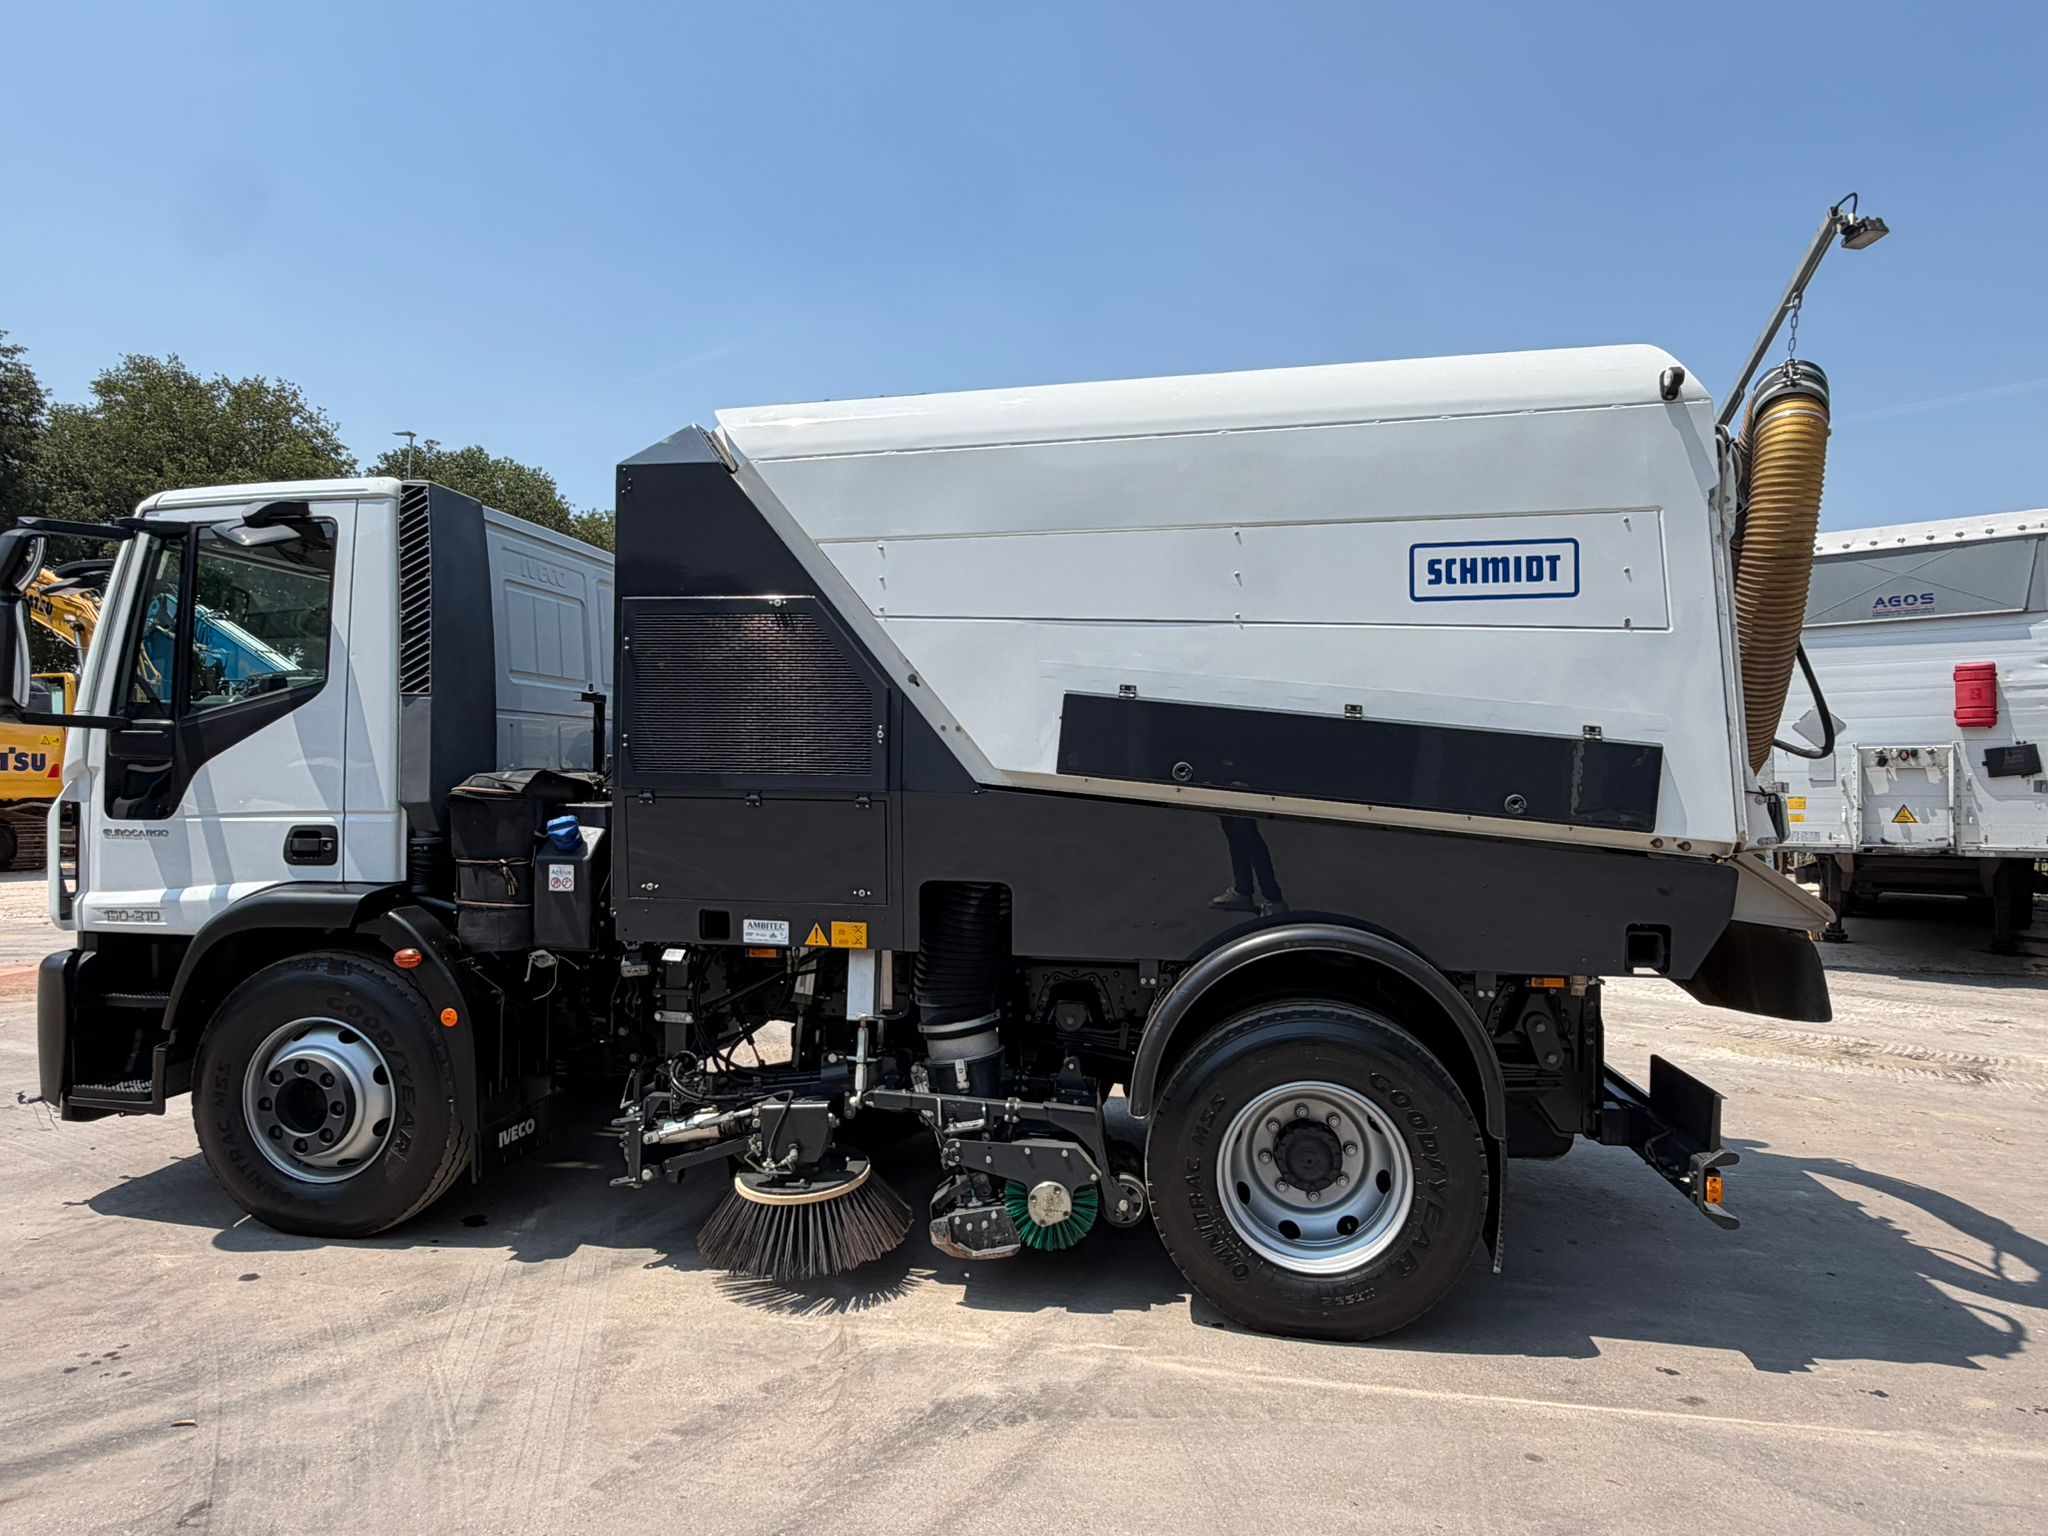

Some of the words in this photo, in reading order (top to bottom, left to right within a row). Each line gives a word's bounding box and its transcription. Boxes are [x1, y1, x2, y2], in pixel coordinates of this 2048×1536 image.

[1427, 554, 1561, 586] SCHMIDT
[1872, 592, 1935, 609] AGOS
[747, 921, 786, 931] AMBITEC
[326, 996, 417, 1158] GOODYEAR
[498, 1118, 536, 1149] IVECO
[1368, 1071, 1449, 1278] GOODYEAR
